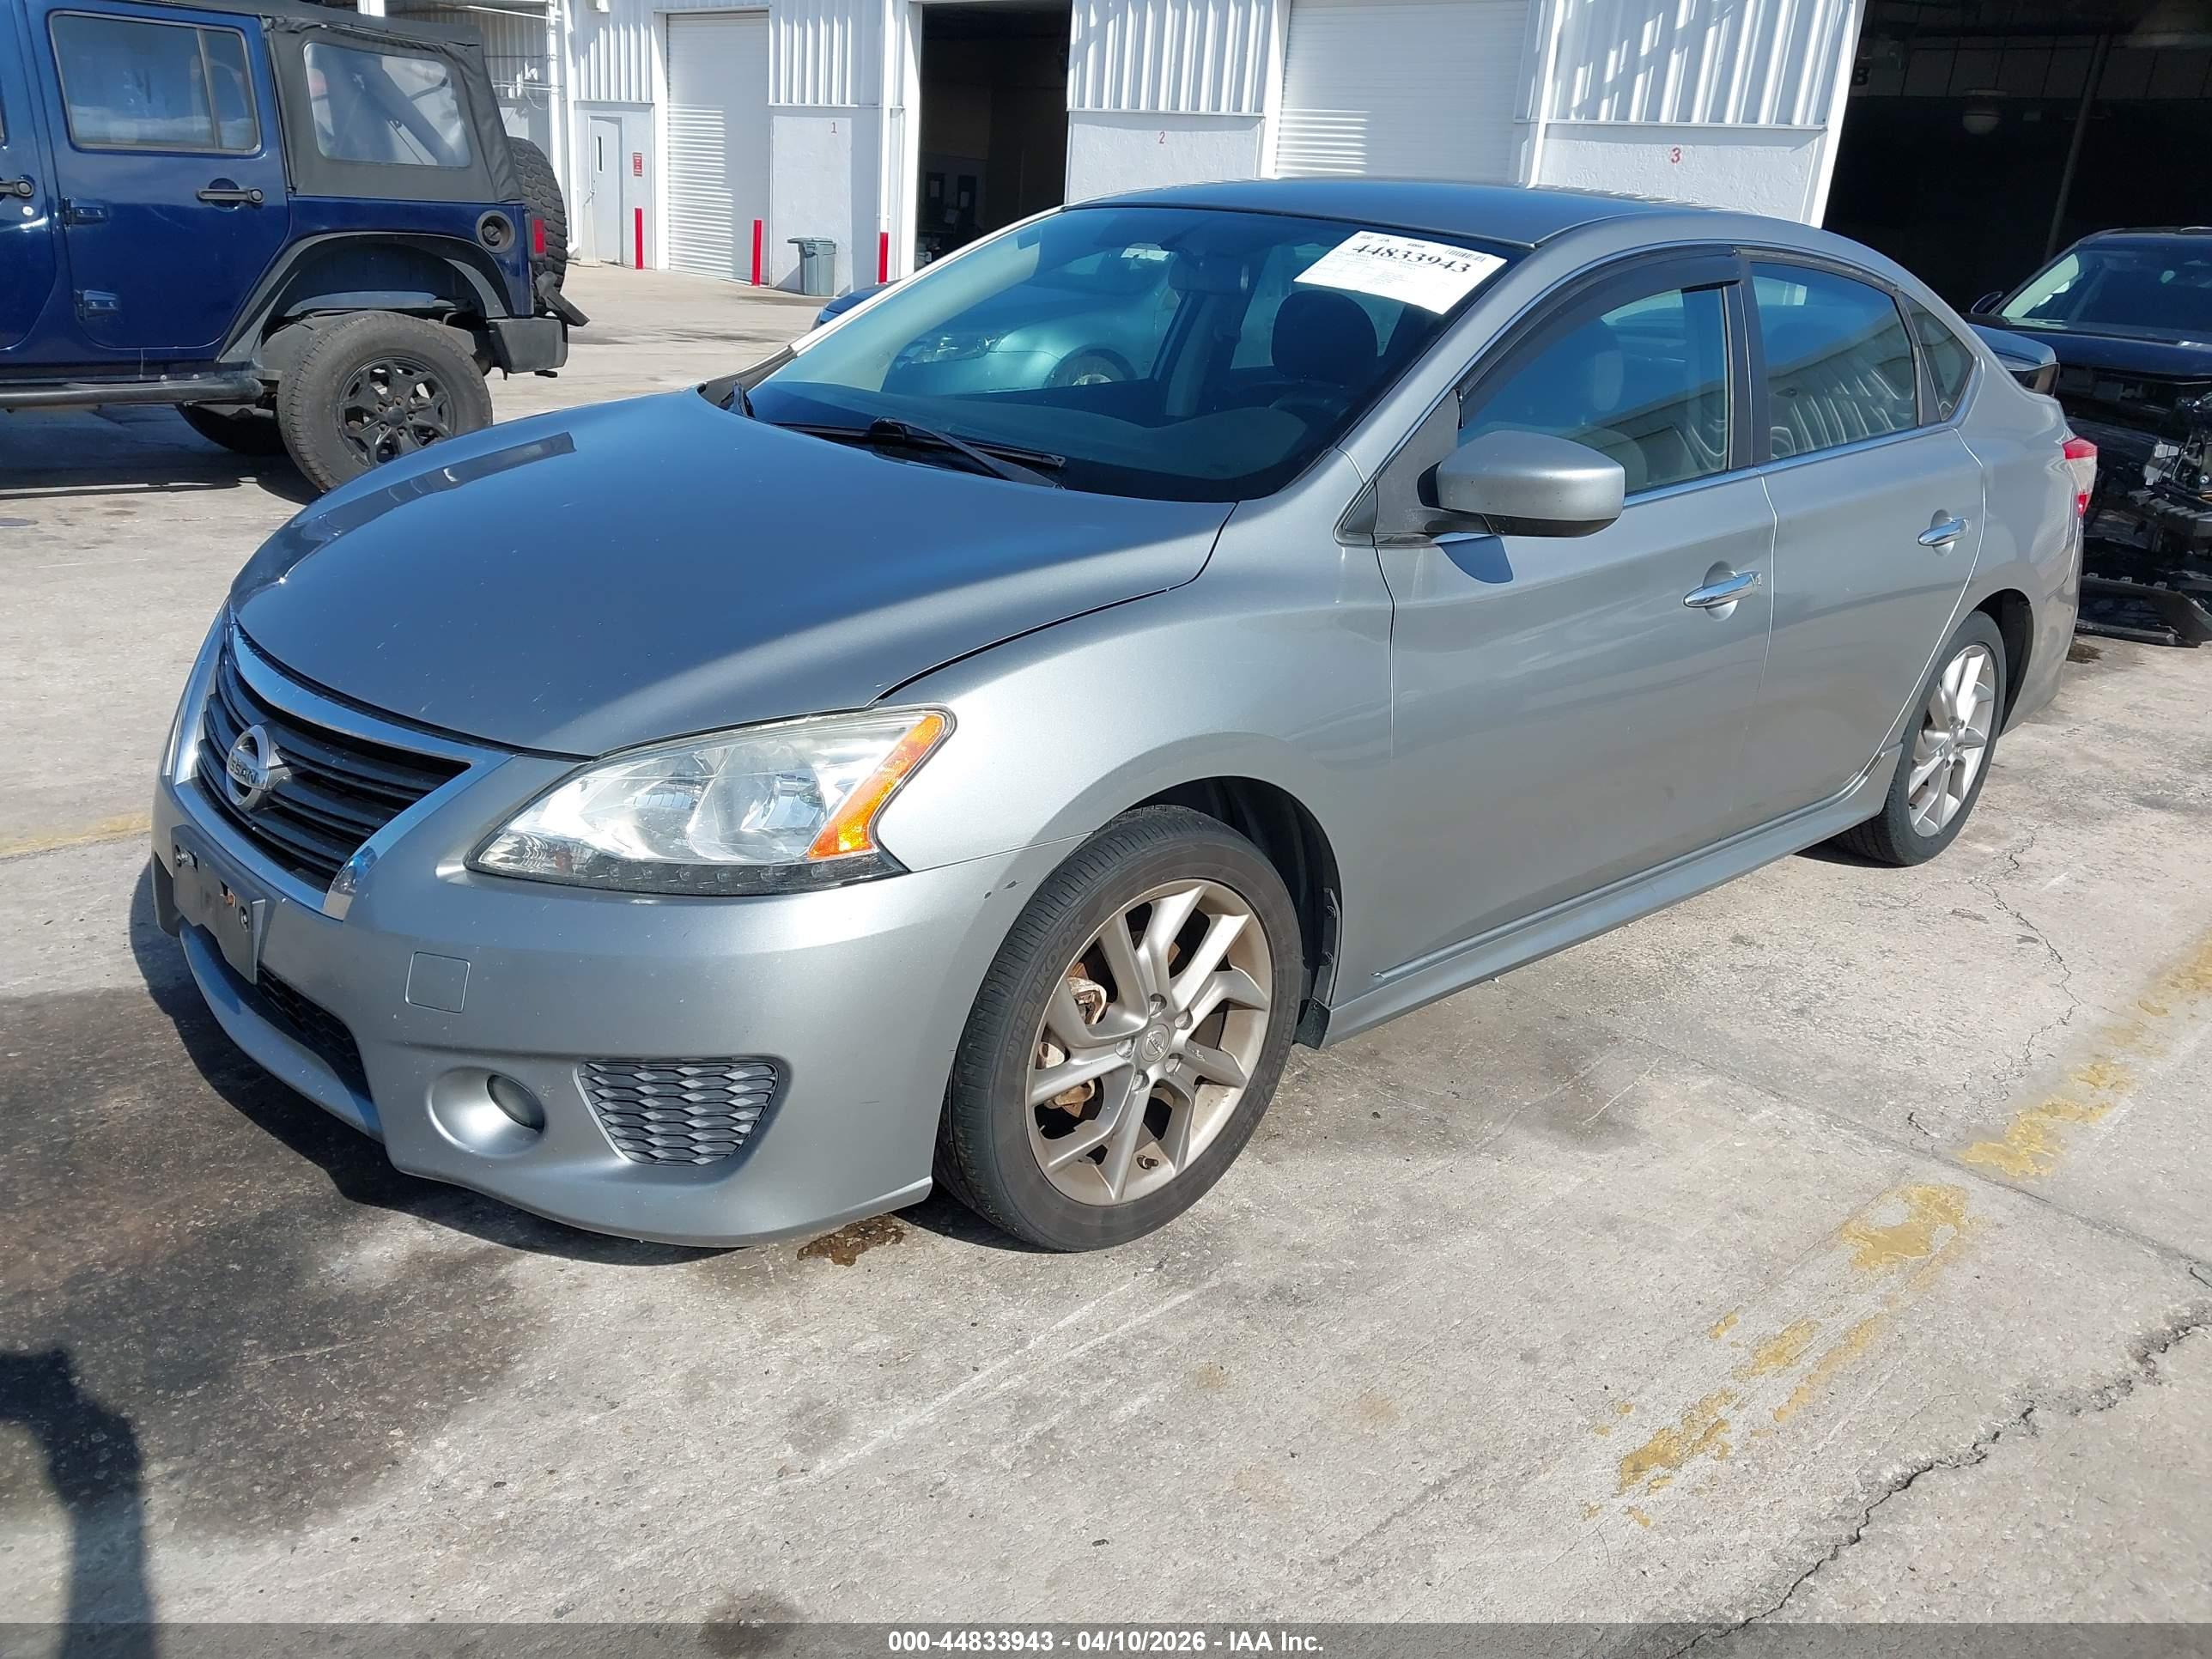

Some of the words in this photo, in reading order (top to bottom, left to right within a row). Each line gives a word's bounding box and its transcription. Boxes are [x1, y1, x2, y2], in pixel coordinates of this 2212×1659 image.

[831, 122, 837, 134] 1
[1159, 131, 1166, 144] 2
[1671, 147, 1680, 163] 3
[1352, 244, 1471, 272] 44833943
